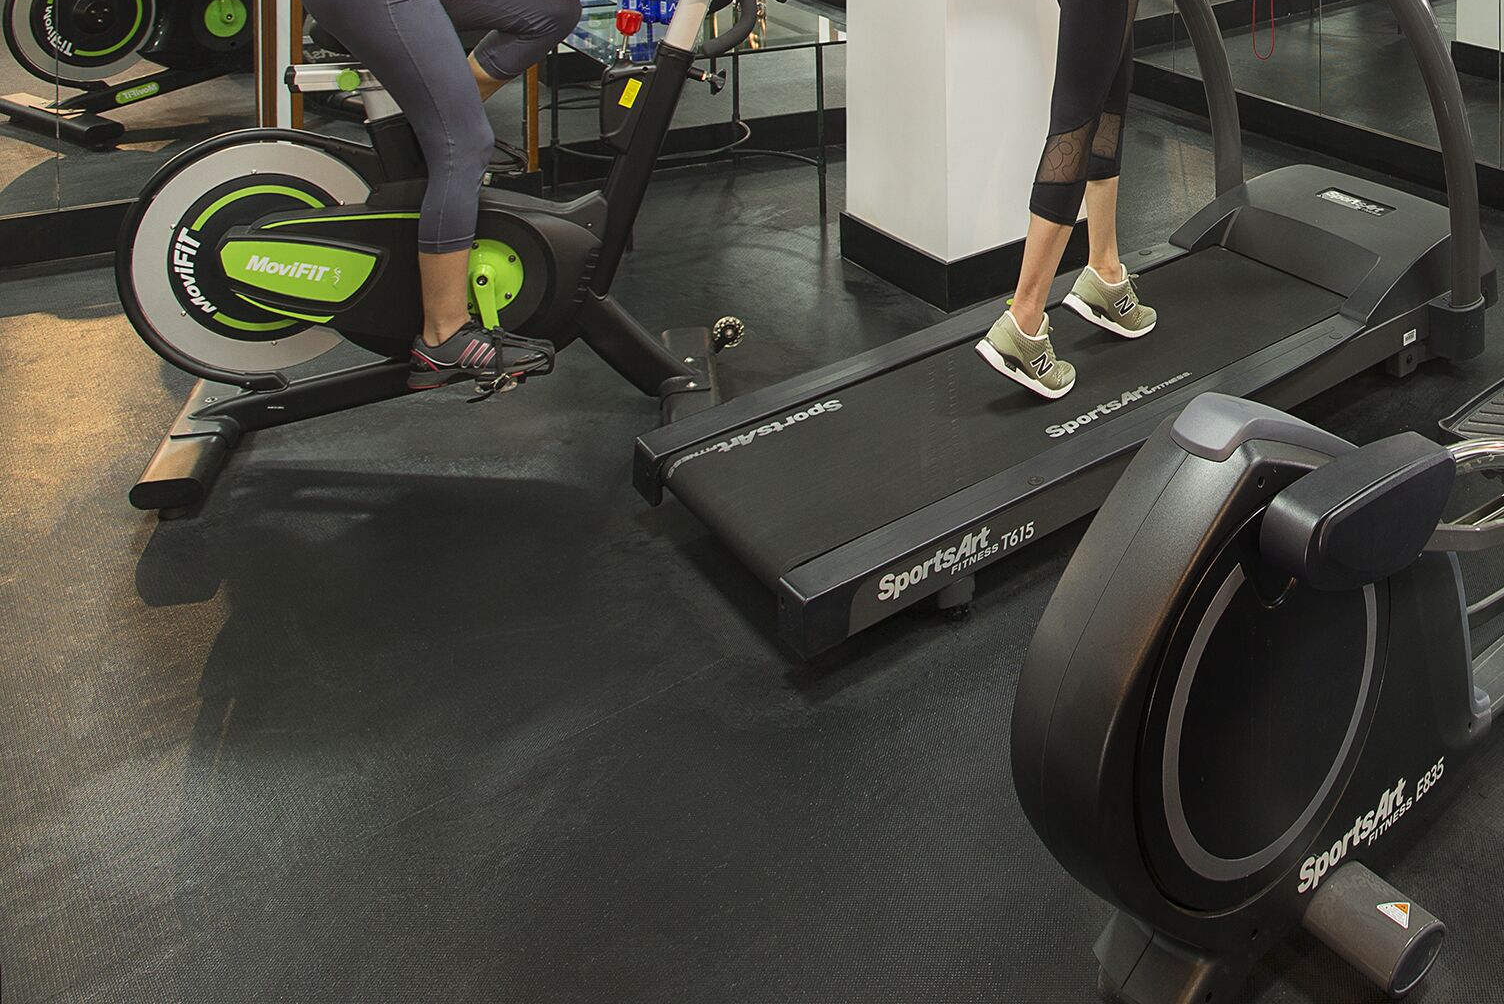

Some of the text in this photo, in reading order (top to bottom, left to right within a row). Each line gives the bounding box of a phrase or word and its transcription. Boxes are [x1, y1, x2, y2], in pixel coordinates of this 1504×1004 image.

[717, 399, 843, 453] SportsArt
[1045, 385, 1152, 438] SportsArt
[877, 525, 991, 601] SportsArt
[951, 521, 1035, 575] FITNESS T615
[1367, 756, 1445, 846] FITNESS E835
[1297, 777, 1407, 893] SportsArt
